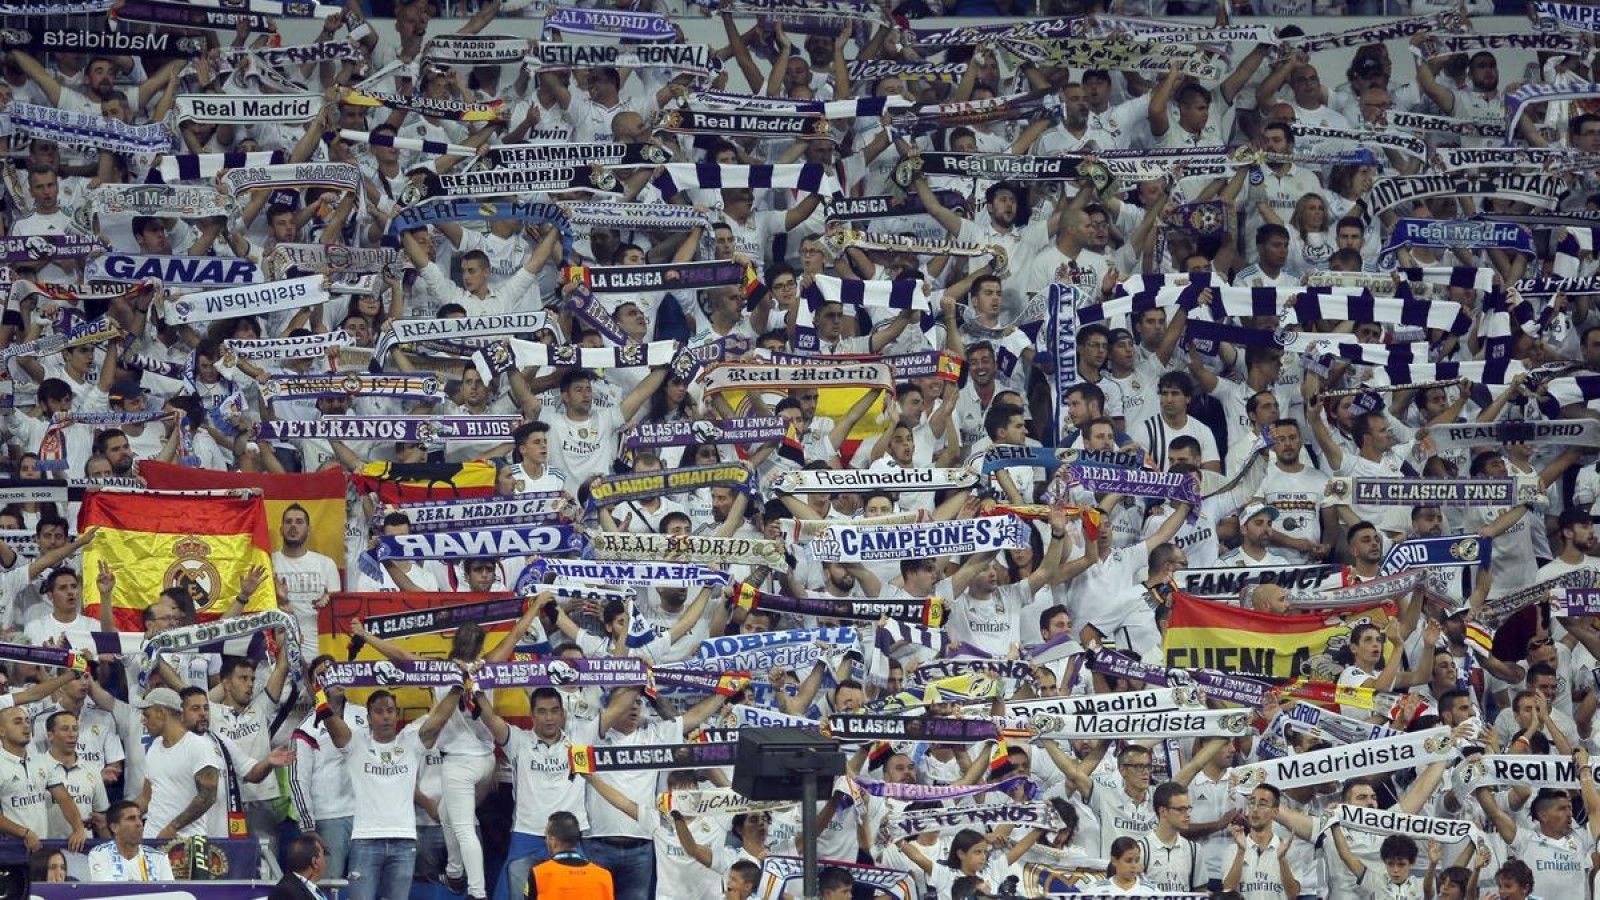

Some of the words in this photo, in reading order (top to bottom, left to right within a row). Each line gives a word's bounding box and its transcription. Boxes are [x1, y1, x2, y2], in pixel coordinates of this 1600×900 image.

[586, 14, 646, 30] MADRID
[429, 40, 451, 49] ALA
[453, 40, 496, 50] MADRID
[1197, 31, 1213, 43] LA
[1219, 30, 1259, 42] CUNA
[1446, 34, 1574, 51] VETERANOS
[454, 51, 461, 59] Y
[463, 50, 493, 59] NADA
[533, 44, 618, 65] ISTIANO
[636, 46, 710, 67] RONAL
[847, 61, 969, 80] Veterano
[1131, 58, 1184, 73] Madrd
[192, 99, 242, 117] Real
[244, 98, 310, 117] Madrid
[694, 114, 737, 128] Real
[740, 115, 805, 132] Madrid
[528, 125, 568, 141] bwin
[549, 144, 628, 161] MADRID
[943, 156, 987, 172] Real
[993, 157, 1062, 174] Madrid
[493, 168, 575, 186] MADRID
[402, 199, 469, 224] REAL
[835, 198, 888, 215] CLASICA
[1407, 223, 1449, 240] Real
[1453, 223, 1519, 241] Madrid
[286, 247, 323, 265] REAL
[350, 247, 399, 265] MADRID
[104, 255, 257, 284] GANAR
[590, 273, 608, 288] LA
[610, 271, 664, 287] CLASICA
[91, 283, 134, 296] MADR
[402, 322, 461, 338] REAL
[465, 314, 538, 333] MADRID
[237, 348, 281, 360] DESDE
[285, 347, 301, 358] LA
[727, 367, 783, 382] Real
[790, 366, 880, 382] Madrid
[268, 420, 407, 440] VETERANOS
[466, 422, 511, 438] HIJOS
[641, 422, 692, 437] CLASICA
[1450, 426, 1498, 441] REAL
[815, 469, 933, 486] Realmadrid
[1082, 466, 1120, 482] REAL
[1126, 469, 1185, 487] MADRID
[1359, 483, 1382, 499] LA
[1387, 482, 1457, 499] CLASICA
[1464, 482, 1507, 499] FANS
[415, 507, 455, 523] REAL
[461, 503, 518, 520] MADRID
[604, 534, 659, 553] REAL
[664, 536, 751, 557] MADRID
[841, 520, 992, 556] CAMPEONES
[1173, 526, 1213, 550] bwin
[939, 543, 974, 555] MADRID
[1567, 593, 1585, 607] LA
[851, 602, 905, 618] CLASICA
[383, 612, 434, 633] CLASICA
[700, 626, 858, 660] DOBLETE
[587, 660, 601, 671] TU
[602, 660, 641, 671] ENVIDIA
[734, 645, 822, 672] Madrid
[1096, 651, 1113, 665] LA
[478, 667, 495, 680] LA
[496, 663, 547, 679] CLASICA
[579, 671, 614, 682] NUESTRO
[614, 671, 648, 682] ORGULLO
[914, 660, 1033, 685] VETERANO
[1199, 684, 1233, 699] UESTRO
[1072, 692, 1158, 716] Madrid
[744, 708, 790, 728] Real
[830, 718, 845, 733] LA
[848, 718, 906, 734] CLASICA
[1074, 712, 1206, 734] Madridista
[594, 751, 613, 766] LA
[615, 749, 674, 766] CLASICA
[1277, 744, 1416, 781] Madridista
[363, 762, 409, 777] Emirates
[1493, 759, 1548, 782] Real
[1341, 805, 1472, 838] Madridista
